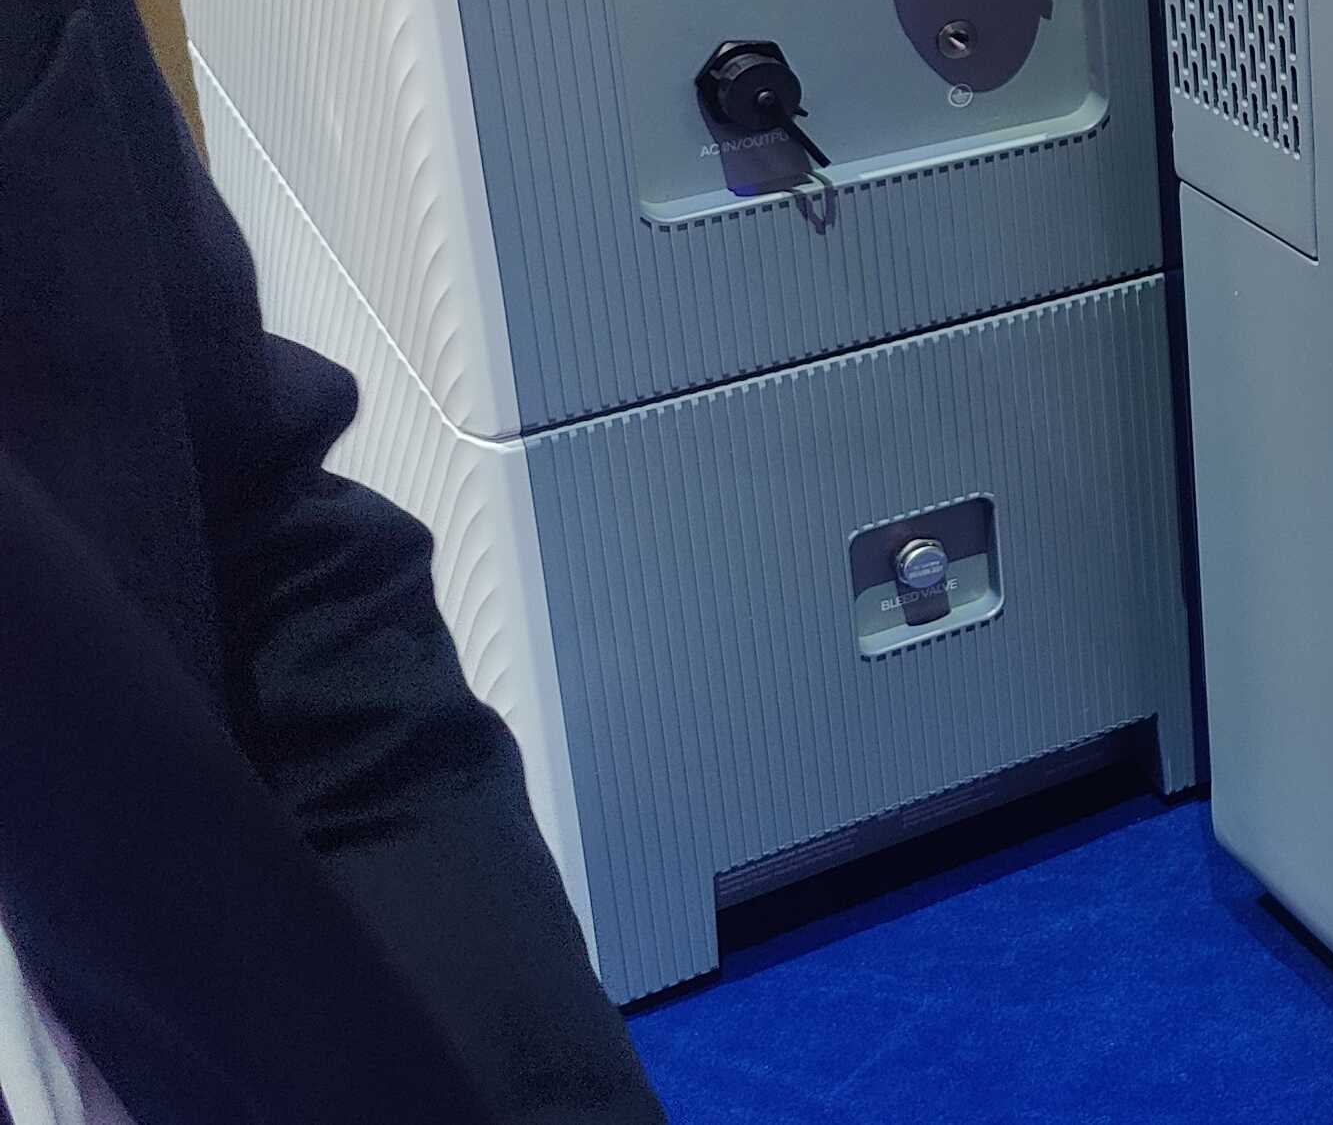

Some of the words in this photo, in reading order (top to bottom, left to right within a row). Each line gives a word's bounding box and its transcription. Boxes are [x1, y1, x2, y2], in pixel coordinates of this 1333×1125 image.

[698, 143, 721, 157] AC
[721, 129, 789, 152] IN/OUTPU
[880, 590, 919, 611] BLEED
[921, 578, 958, 599] VALVE
